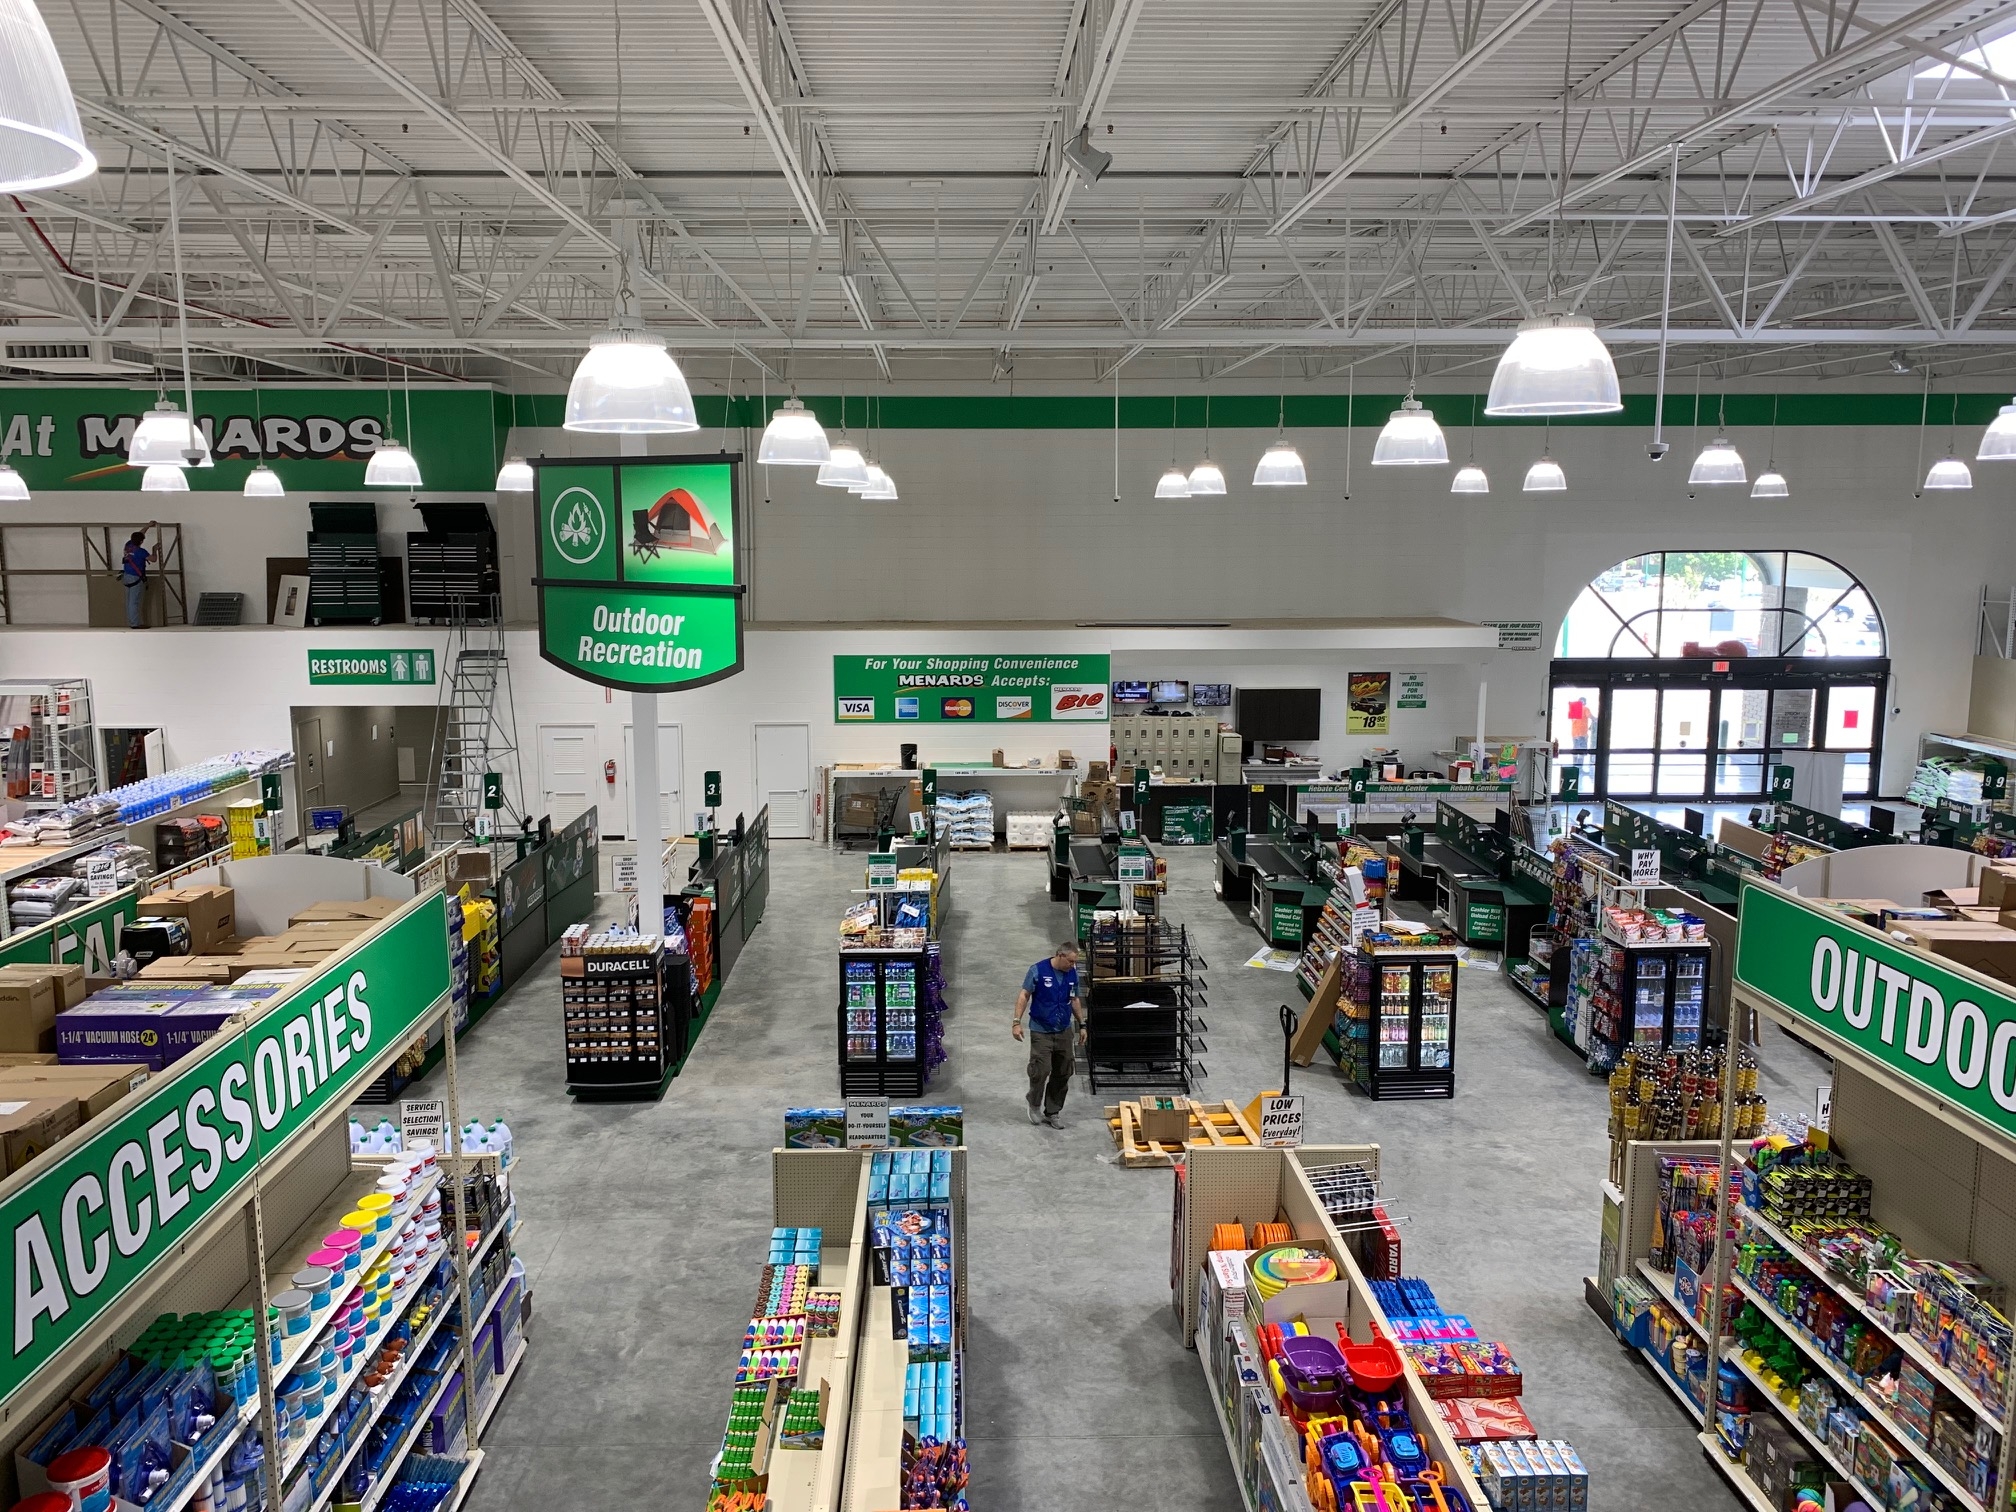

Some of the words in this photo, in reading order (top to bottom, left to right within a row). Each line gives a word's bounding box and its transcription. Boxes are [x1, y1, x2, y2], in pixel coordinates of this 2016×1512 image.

[3, 415, 56, 457] At
[82, 416, 383, 453] MARDS
[593, 605, 685, 636] Outdoor
[578, 636, 702, 670] Recreation
[311, 659, 387, 674] RESTROOMS
[865, 658, 890, 670] For
[892, 658, 922, 670] Your
[926, 658, 989, 672] Shopping
[994, 658, 1079, 670] Convenience
[898, 674, 984, 687] MENARDS
[991, 674, 1050, 688] Accepts:
[843, 703, 870, 713] VISA
[1363, 716, 1376, 728] 18
[925, 782, 933, 793] 4
[1138, 781, 1146, 792] 5
[1354, 780, 1363, 792] 6
[1568, 779, 1576, 790] 7
[1782, 778, 1791, 789] 8
[1985, 776, 1992, 787] 9
[1996, 777, 2005, 788] 9
[266, 786, 272, 798] 1
[487, 786, 497, 796] 2
[707, 784, 715, 795] 3
[1639, 860, 1653, 868] PAY
[1633, 868, 1658, 876] MORE?
[587, 960, 650, 972] DURACELL
[61, 1031, 84, 1044] 1-1/4"
[85, 1031, 119, 1043] VACUUM
[120, 1031, 140, 1043] HOSE
[166, 1031, 190, 1044] 1-1/4"
[406, 1103, 437, 1111] SERVICE!
[1270, 1099, 1294, 1110] LOW
[402, 1115, 442, 1124] SELECTION!
[1263, 1113, 1301, 1126] PRICES
[406, 1128, 438, 1136] SAVINGS!
[1262, 1126, 1301, 1138] Everyday!
[14, 970, 372, 1357] ACCESSORIES
[1389, 1244, 1398, 1274] YARD
[5, 1409, 10, 1422] F
[423, 1430, 432, 1447] HOSE
